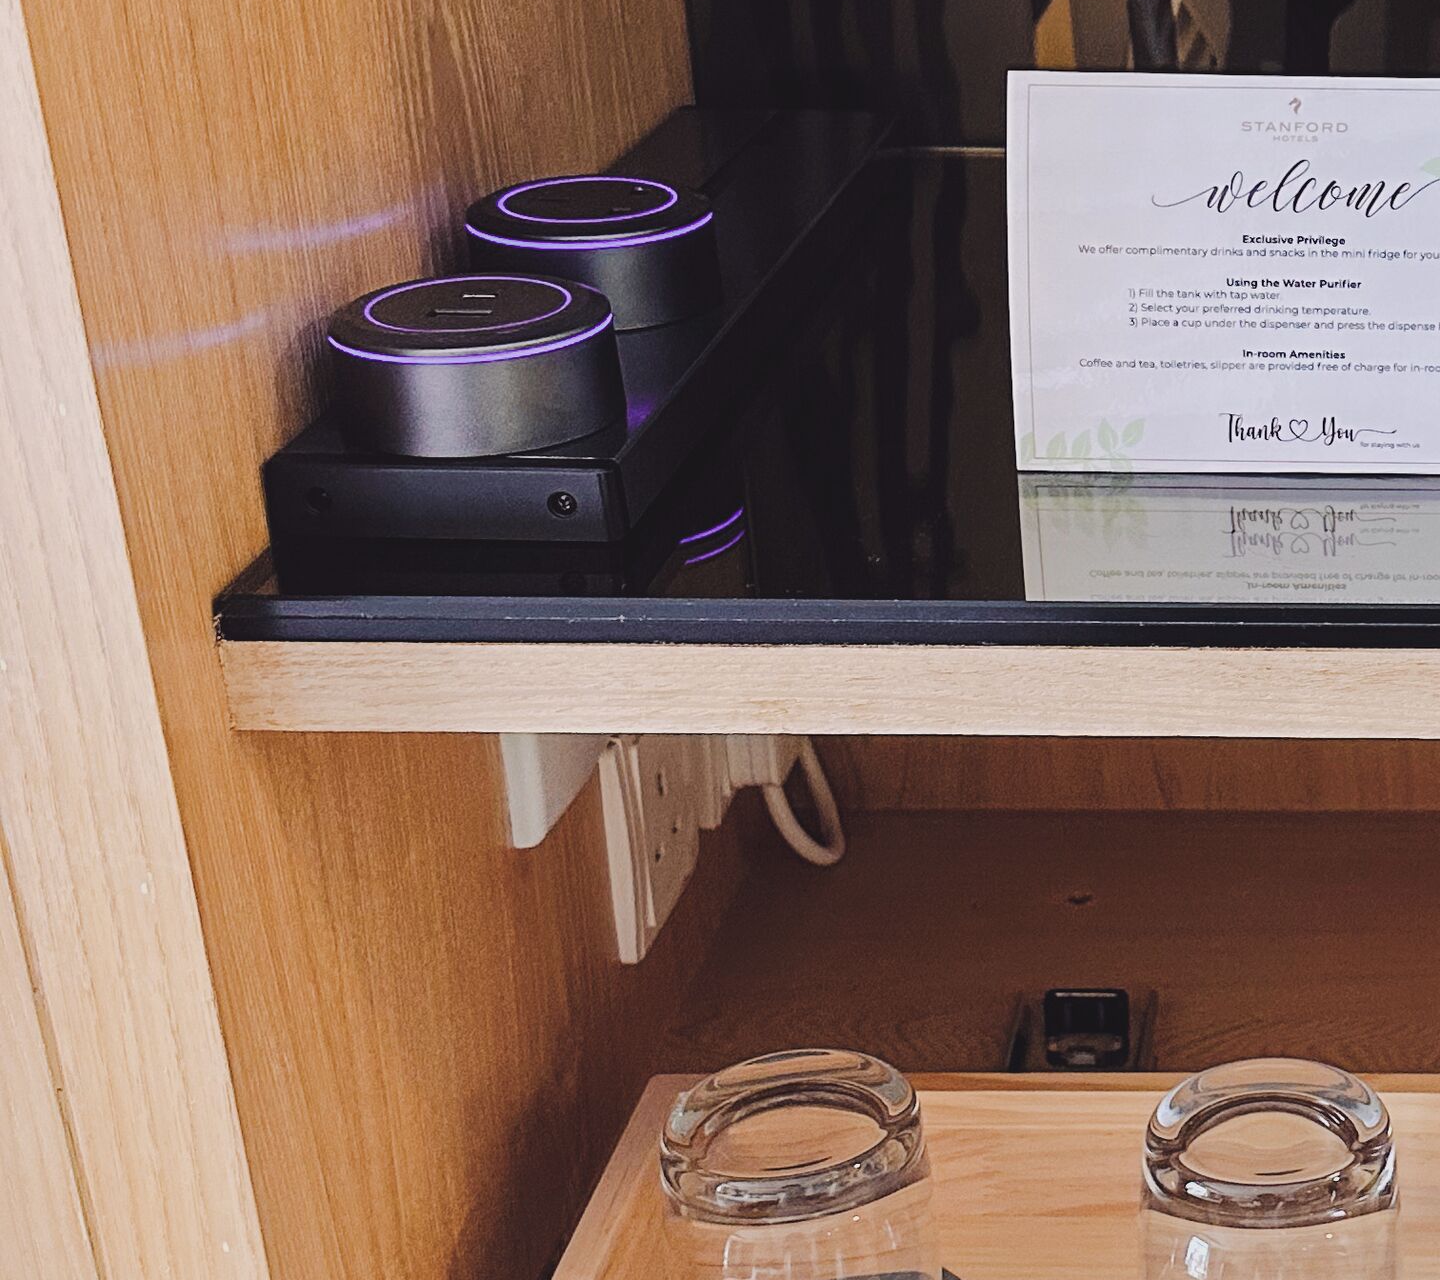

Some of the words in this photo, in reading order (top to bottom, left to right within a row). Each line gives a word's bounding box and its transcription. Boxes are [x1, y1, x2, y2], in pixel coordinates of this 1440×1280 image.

[1241, 121, 1349, 133] STANFORD
[1272, 135, 1319, 143] HOTELS
[1242, 234, 1294, 245] Exclusive
[1297, 235, 1346, 248] Privilege
[1078, 245, 1097, 255] We
[1099, 245, 1123, 256] offer
[1125, 246, 1208, 258] complimentary
[1210, 247, 1244, 257] drinks
[1246, 248, 1267, 258] and
[1269, 248, 1305, 258] snacks
[1308, 248, 1319, 258] in
[1320, 249, 1339, 258] the
[1341, 249, 1366, 259] mini
[1368, 249, 1401, 261] fridge
[1403, 250, 1418, 260] for
[1226, 278, 1258, 290] Using
[1261, 278, 1280, 288] the
[1283, 279, 1316, 289] Water
[1319, 279, 1362, 290] Purifier
[1128, 288, 1136, 299] 1)
[1138, 288, 1154, 299] Fill
[1156, 288, 1174, 299] the
[1176, 289, 1201, 299] tank
[1203, 289, 1227, 300] with
[1229, 290, 1248, 302] tap
[1128, 303, 1138, 314] 2)
[1140, 303, 1173, 313] Select
[1175, 305, 1200, 315] your
[1202, 304, 1251, 316] preferred
[1253, 305, 1299, 318] drinking
[1128, 317, 1138, 328] 3)
[1141, 317, 1171, 328] Place
[1172, 320, 1179, 328] a
[1181, 320, 1202, 330] cup
[1204, 318, 1236, 329] under
[1239, 319, 1257, 329] the
[1259, 319, 1311, 331] dispenser
[1313, 320, 1335, 330] and
[1337, 322, 1366, 332] press
[1367, 321, 1386, 331] the
[1388, 321, 1436, 333] dispense
[1242, 349, 1287, 359] In-room
[1289, 350, 1346, 360] Amenities
[1079, 358, 1113, 368] Coffee
[1115, 359, 1136, 369] and
[1210, 360, 1246, 372] slipper
[1248, 362, 1266, 371] are
[1268, 361, 1315, 373] provided
[1317, 362, 1339, 372] free
[1341, 362, 1352, 372] of
[1354, 362, 1391, 374] charge
[1393, 363, 1408, 373] for
[1219, 412, 1282, 443] Thank
